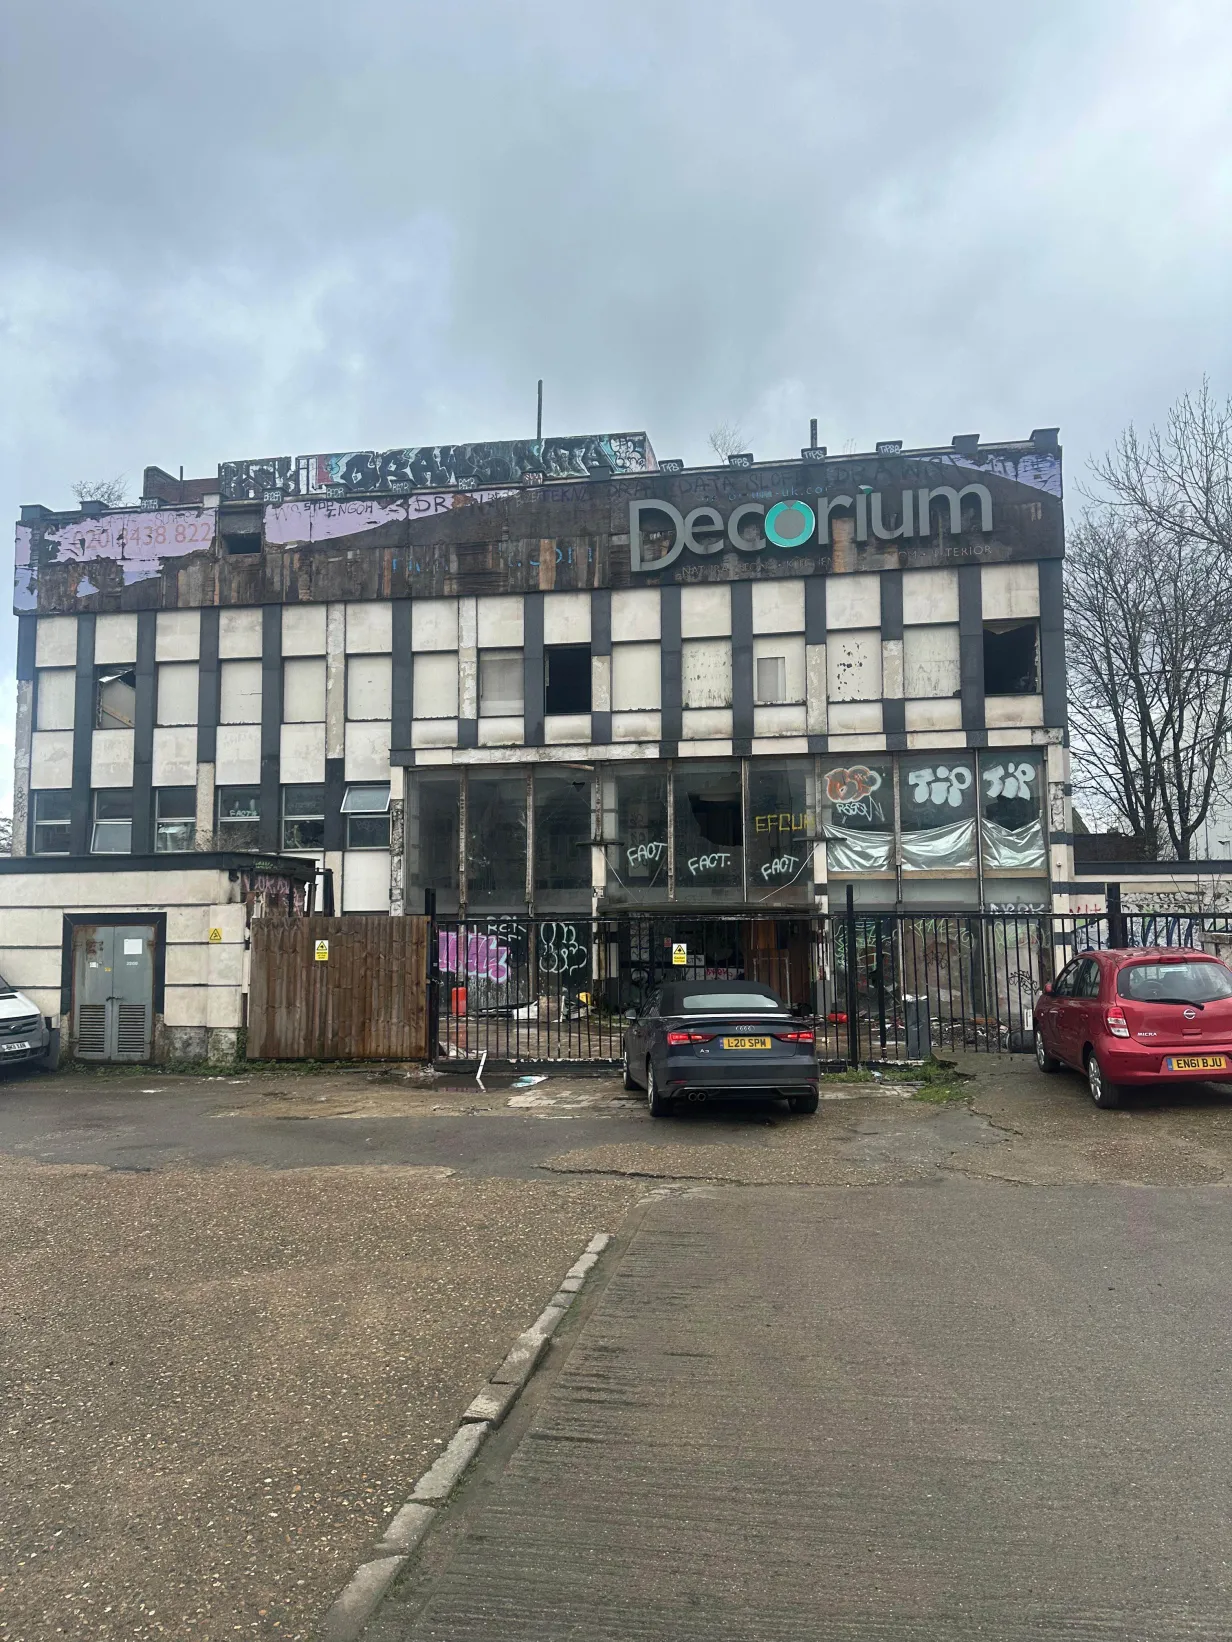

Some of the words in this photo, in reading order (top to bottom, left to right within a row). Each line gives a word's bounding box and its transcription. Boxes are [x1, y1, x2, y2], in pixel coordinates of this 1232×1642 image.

[629, 483, 993, 572] Decorium
[627, 842, 668, 866] FACT
[761, 854, 799, 880] FACT
[1176, 1058, 1200, 1069] EN61
[1202, 1057, 1222, 1068] BJU
